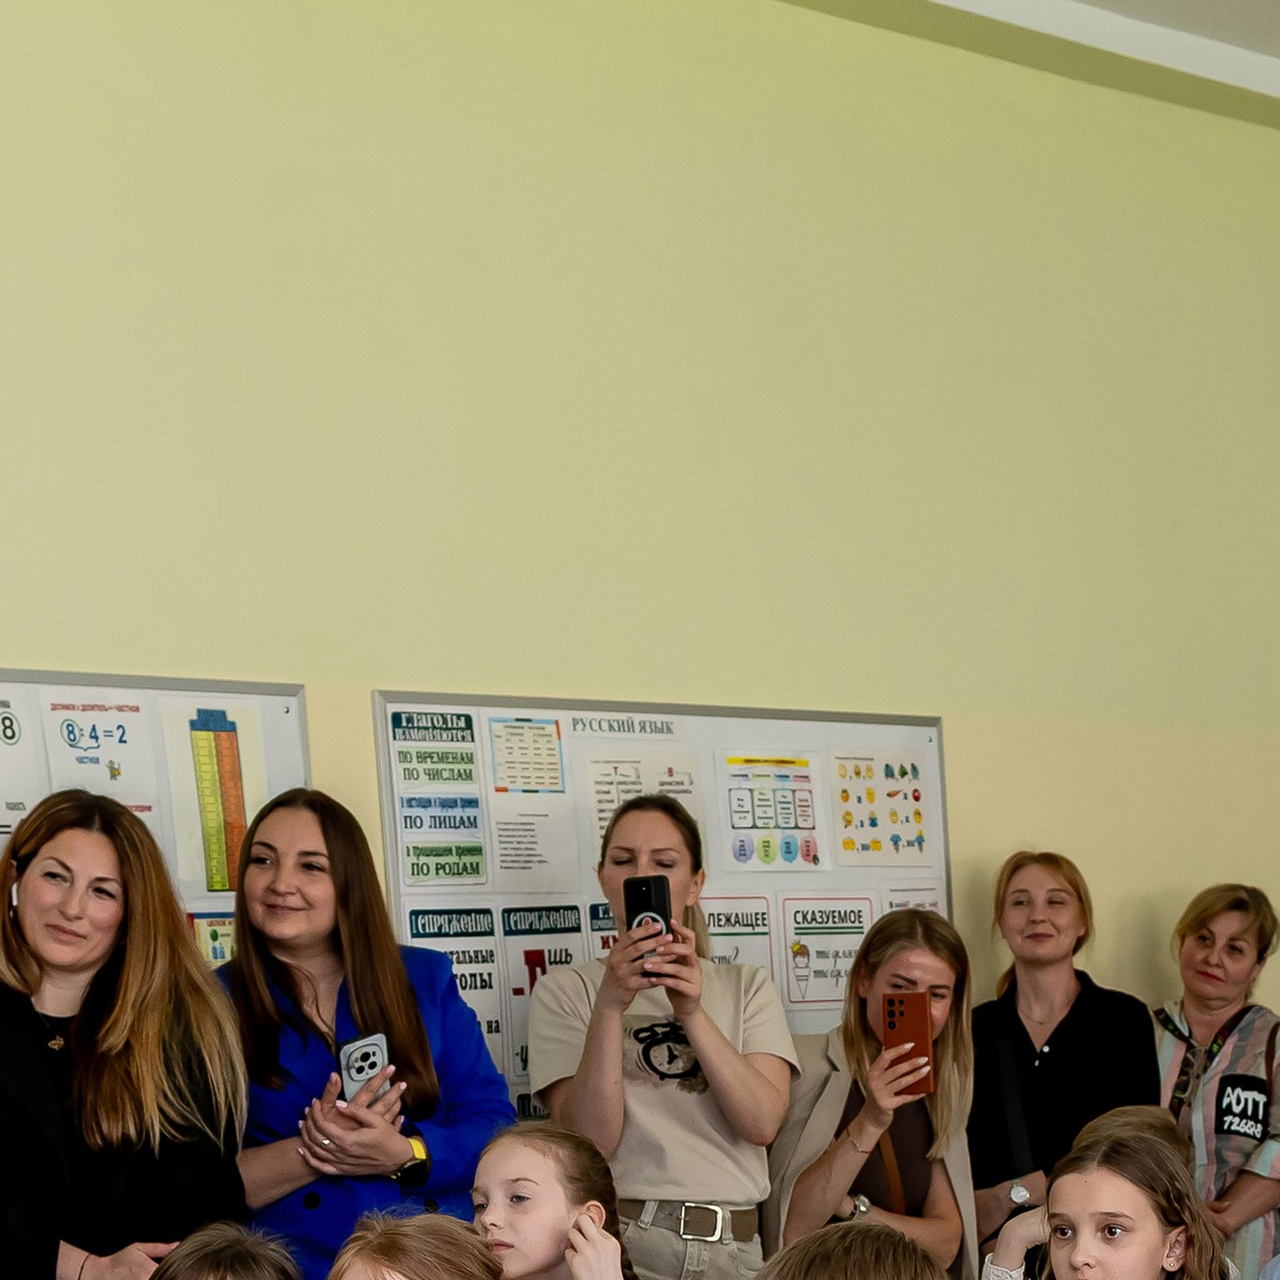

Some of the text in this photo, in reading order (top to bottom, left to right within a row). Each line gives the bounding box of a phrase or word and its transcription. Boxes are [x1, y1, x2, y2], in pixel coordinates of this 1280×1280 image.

[572, 716, 674, 734] РУССКИЙ ЯЗЫК
[66, 723, 77, 742] 8
[89, 723, 99, 743] 4
[116, 724, 128, 744] 2
[416, 751, 474, 764] ВРЕМЕНАМ
[403, 767, 473, 781] ПО ЧИСЛАМ
[404, 815, 478, 830] ПО ЛИЦАМ
[411, 862, 480, 876] ПО РОДАМ
[793, 909, 863, 926] СКАЗУЕМОЕ
[486, 1019, 500, 1034] на
